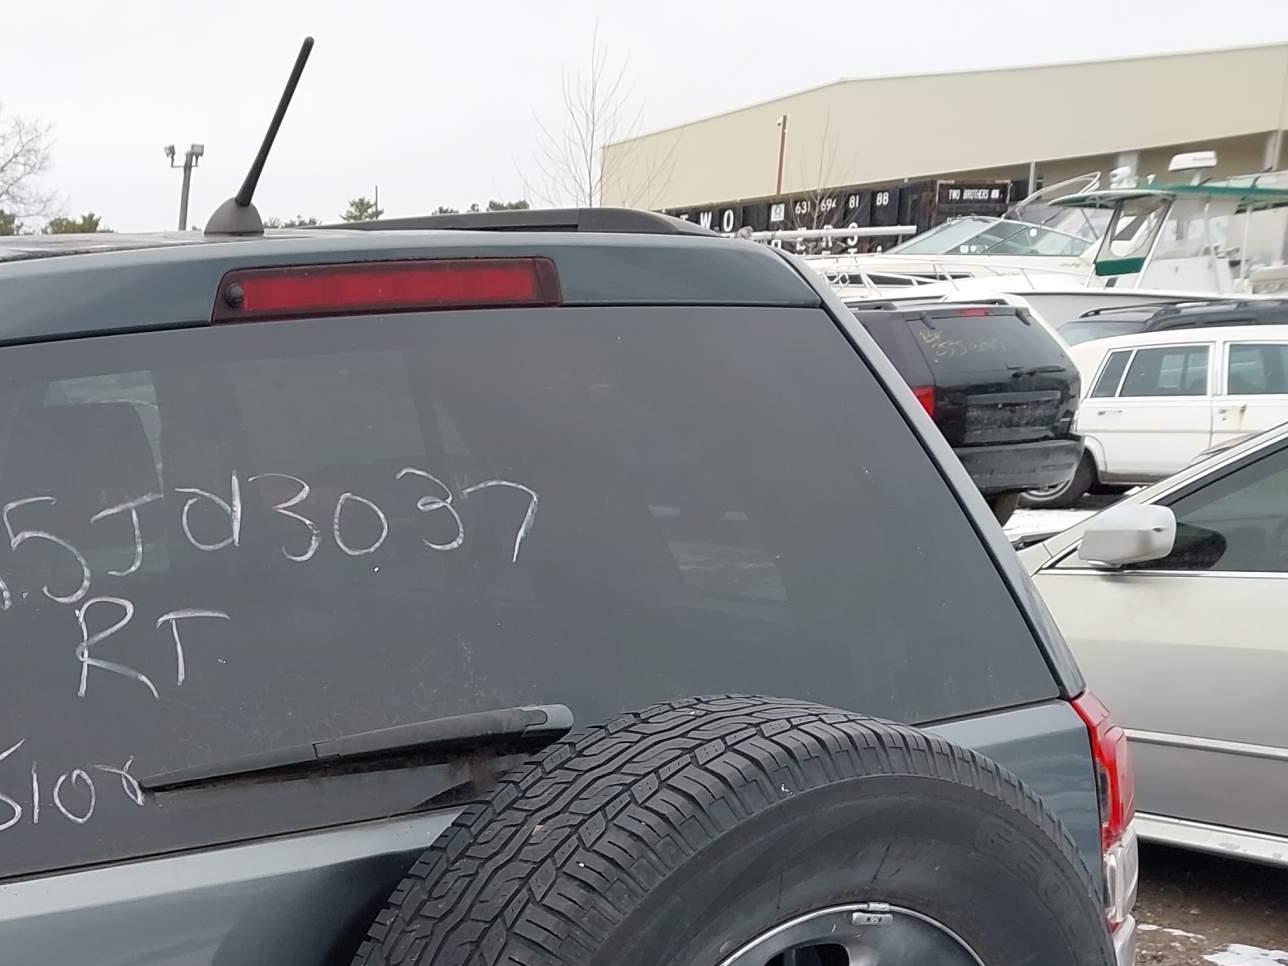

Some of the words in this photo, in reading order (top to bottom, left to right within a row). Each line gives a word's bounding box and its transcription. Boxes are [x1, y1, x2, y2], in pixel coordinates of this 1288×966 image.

[795, 201, 811, 214] 631
[849, 194, 860, 209] 81
[876, 192, 889, 206] 88
